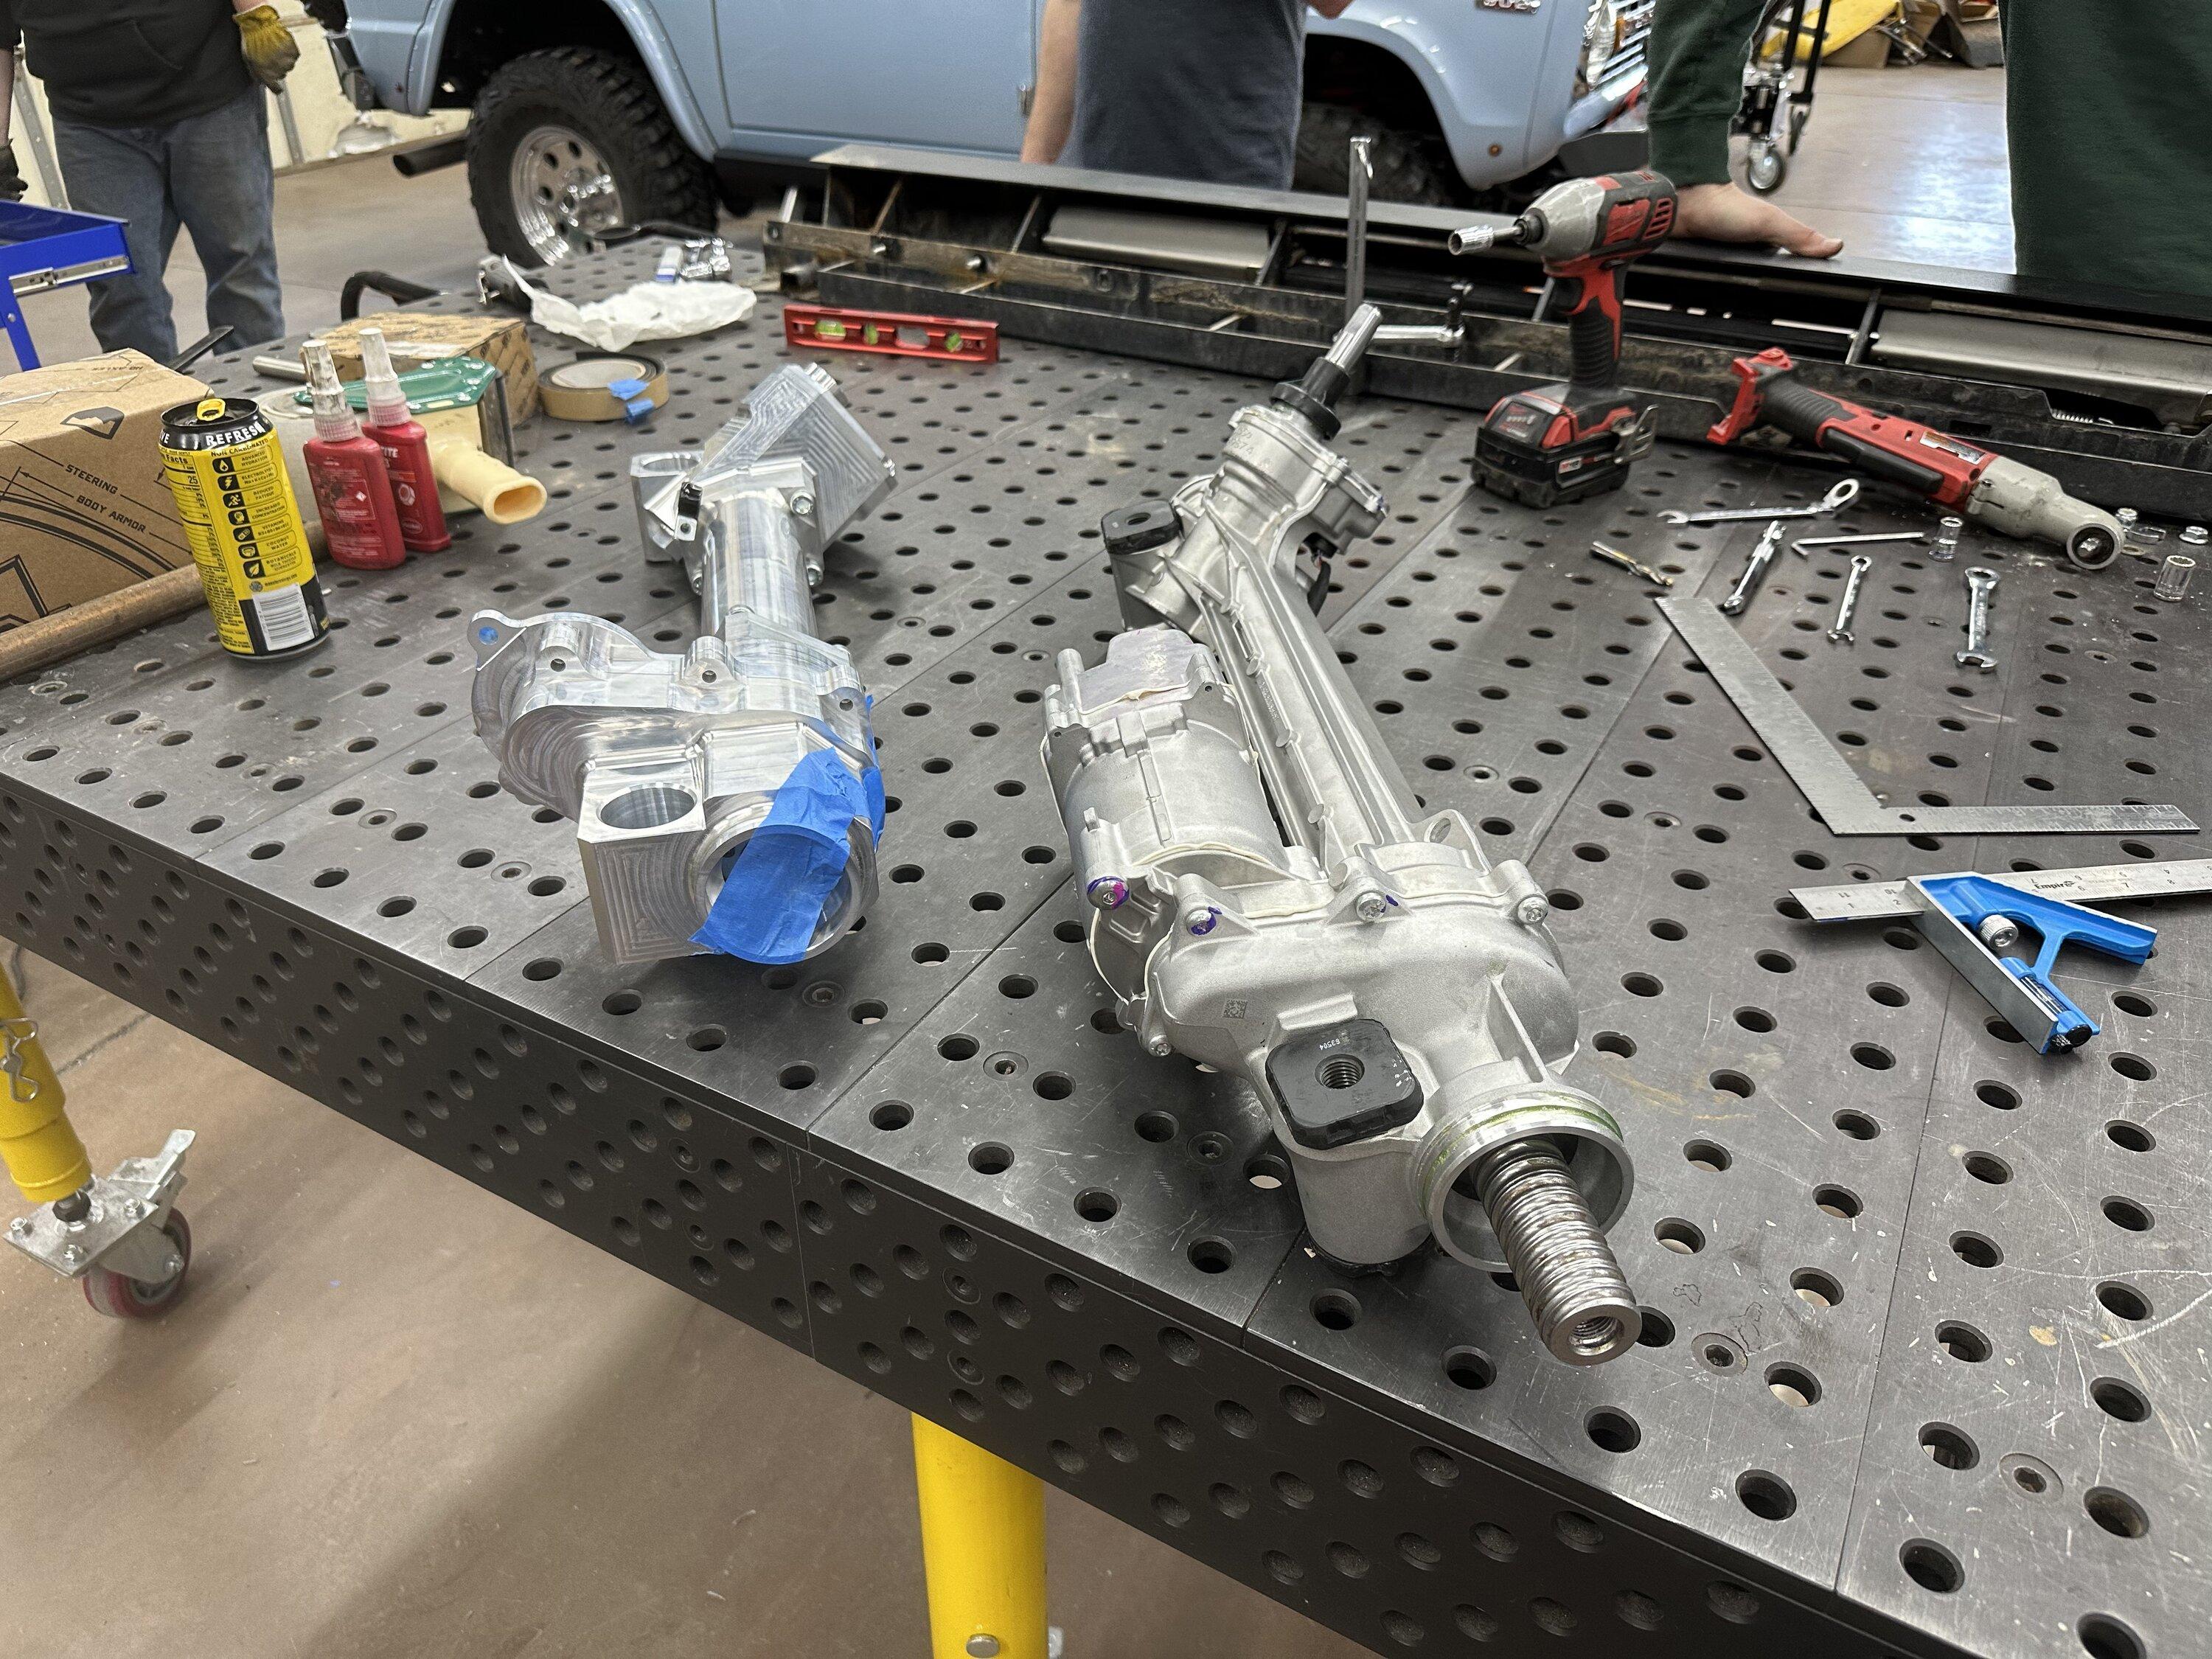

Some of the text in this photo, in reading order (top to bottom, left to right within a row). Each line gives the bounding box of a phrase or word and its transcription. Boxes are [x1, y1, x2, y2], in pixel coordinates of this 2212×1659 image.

[166, 453, 188, 465] Facts
[66, 464, 119, 495] STEERING
[187, 476, 198, 484] 25
[76, 495, 146, 533] BODY ARMOR
[271, 541, 288, 551] WATER
